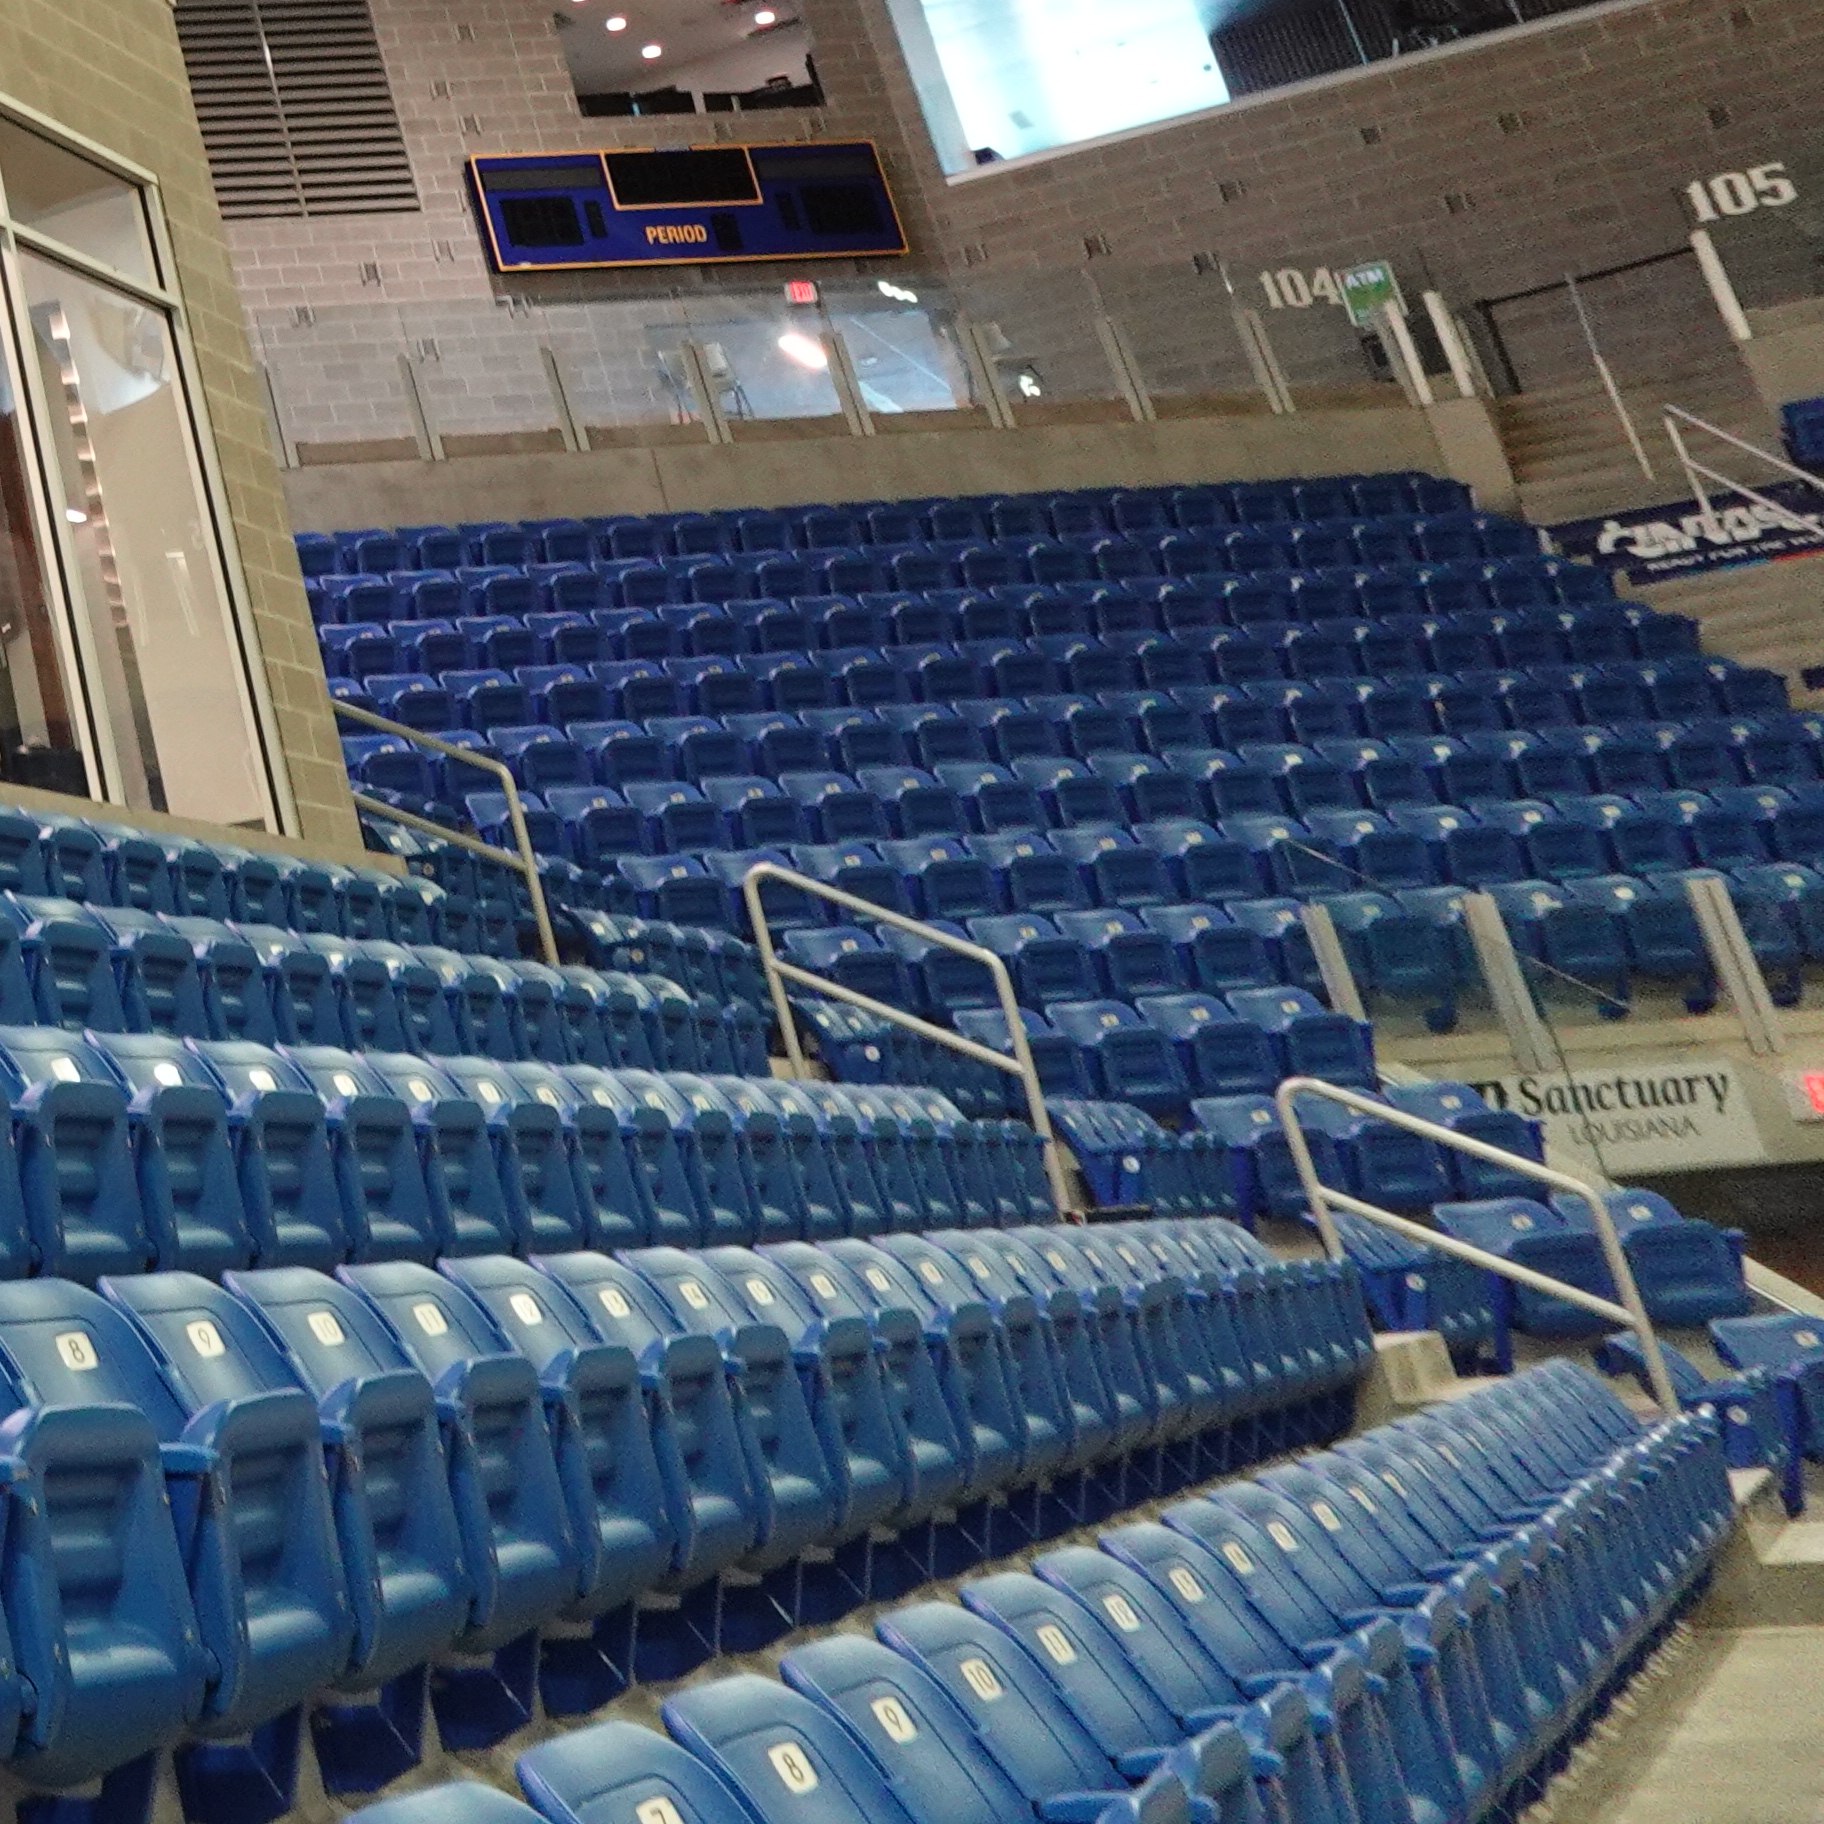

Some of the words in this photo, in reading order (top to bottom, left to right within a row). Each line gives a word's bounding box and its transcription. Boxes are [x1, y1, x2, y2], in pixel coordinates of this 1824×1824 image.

[1685, 161, 1799, 223] 105
[645, 224, 708, 246] PERIOD
[1259, 266, 1343, 309] 104
[1519, 1073, 1729, 1115] Sanctuary
[1567, 1115, 1702, 1147] LOUISIANA
[67, 1338, 86, 1364] 8
[197, 1327, 212, 1350] 9
[968, 1665, 997, 1692] 10
[883, 1704, 902, 1732] 9
[782, 1752, 804, 1782] 8
